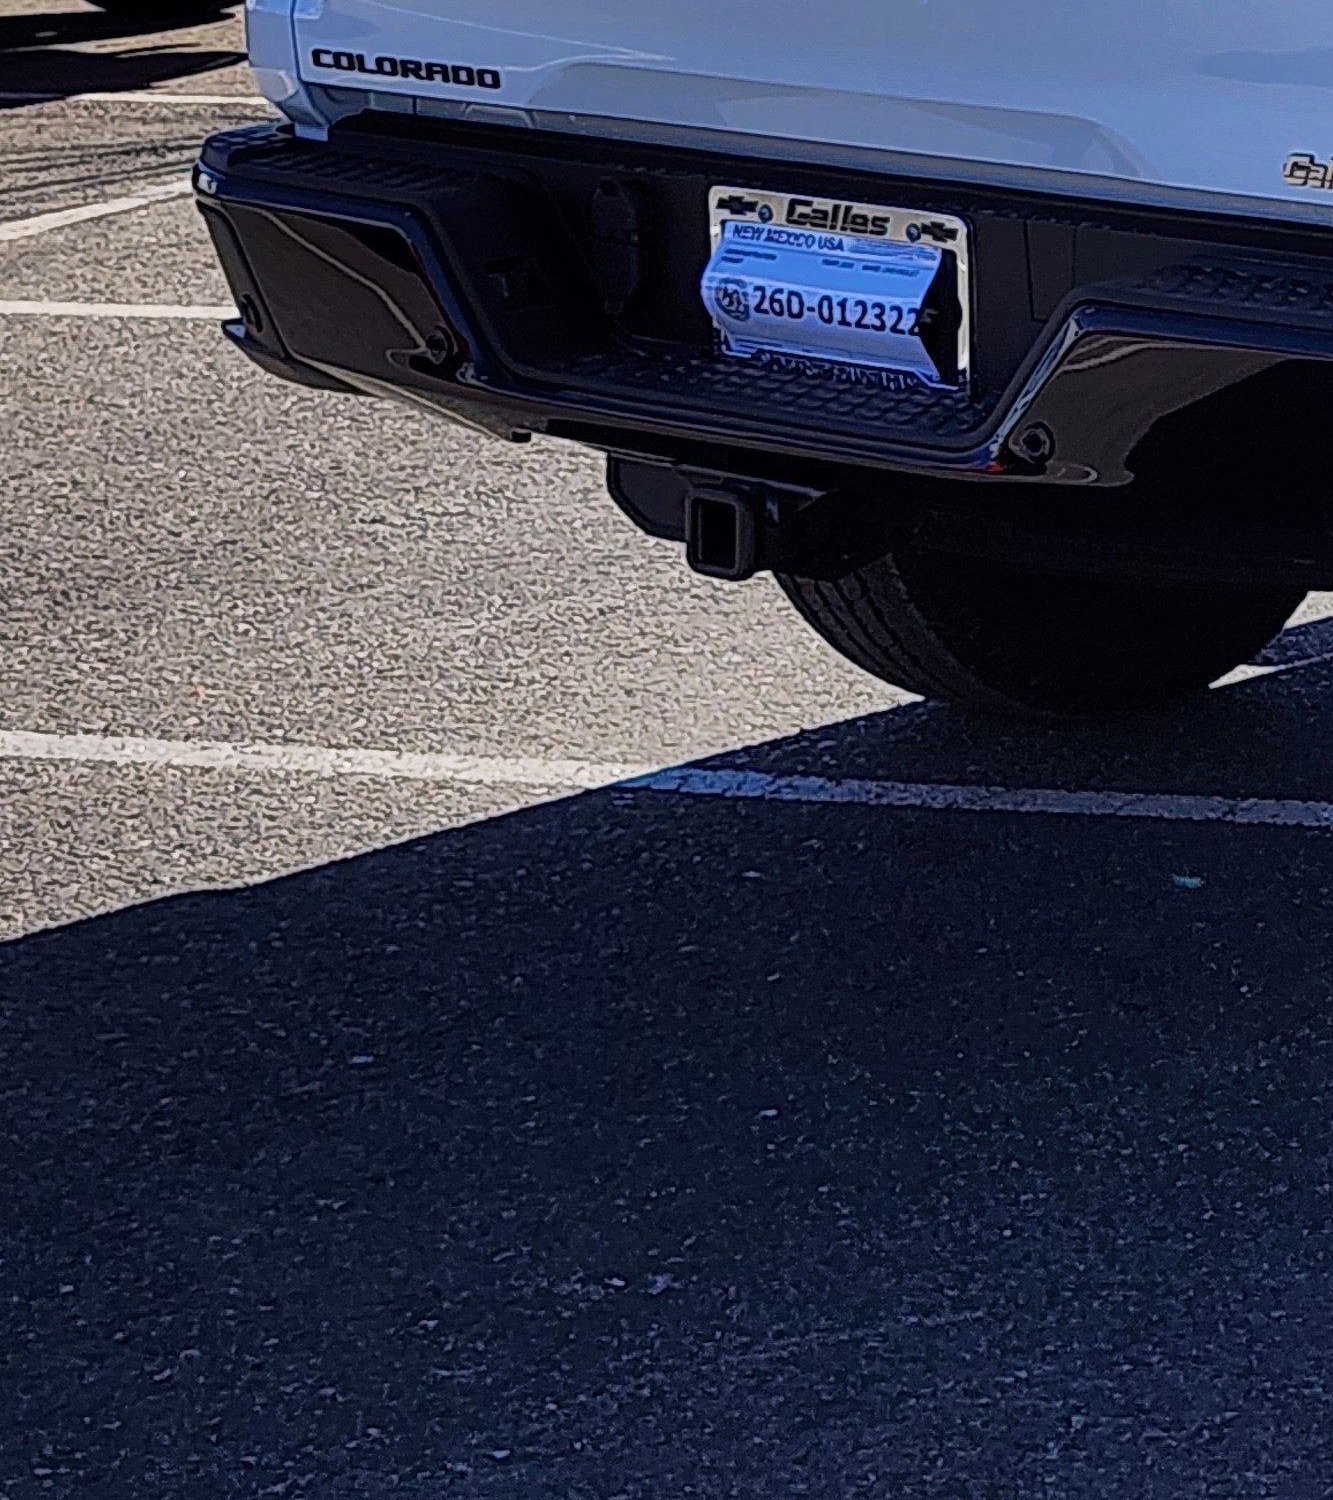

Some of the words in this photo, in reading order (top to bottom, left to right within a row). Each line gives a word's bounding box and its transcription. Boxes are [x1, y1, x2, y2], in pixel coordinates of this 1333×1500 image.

[311, 48, 501, 89] COLORADO
[733, 225, 761, 242] NEW
[818, 234, 845, 252] USA
